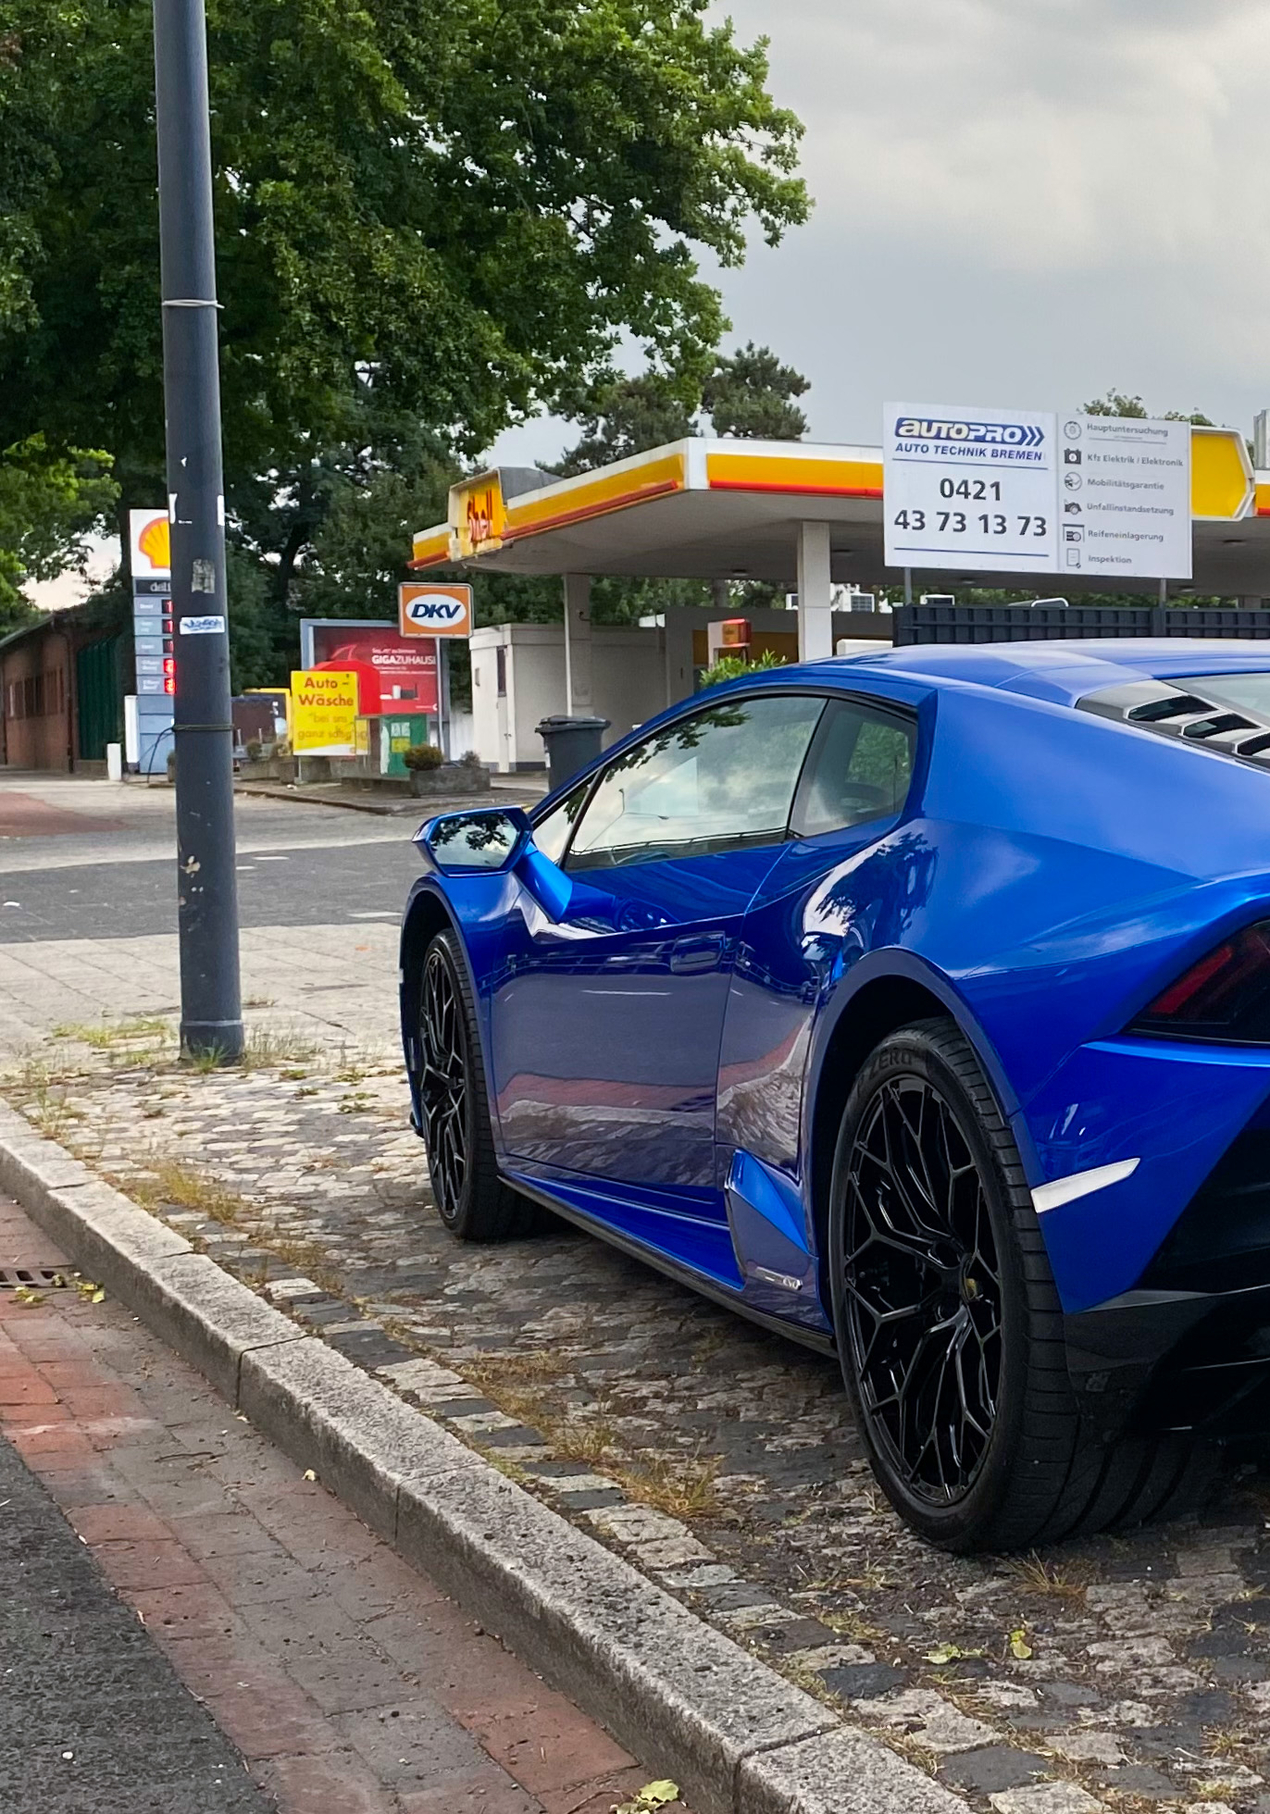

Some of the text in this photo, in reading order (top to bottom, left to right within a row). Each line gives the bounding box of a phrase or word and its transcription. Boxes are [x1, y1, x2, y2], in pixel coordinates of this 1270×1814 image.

[1087, 423, 1168, 437] Hauptuntersuchung
[895, 443, 1042, 461] AUTO TECHNIK BREMEN
[1103, 455, 1135, 464] Elektrik
[1141, 457, 1183, 467] Elektronik
[940, 478, 1001, 501] 0421
[1087, 478, 1165, 491] Mobilitätsgarantie
[1087, 503, 1174, 516] Unfallinstandsetzung
[894, 510, 1047, 537] 43 73 13 73
[1088, 530, 1164, 542] Reifeneinlagerung
[1088, 555, 1132, 564] Inspektion
[411, 603, 461, 619] DKV
[304, 677, 338, 689] Auto
[298, 693, 354, 706] Wäsche
